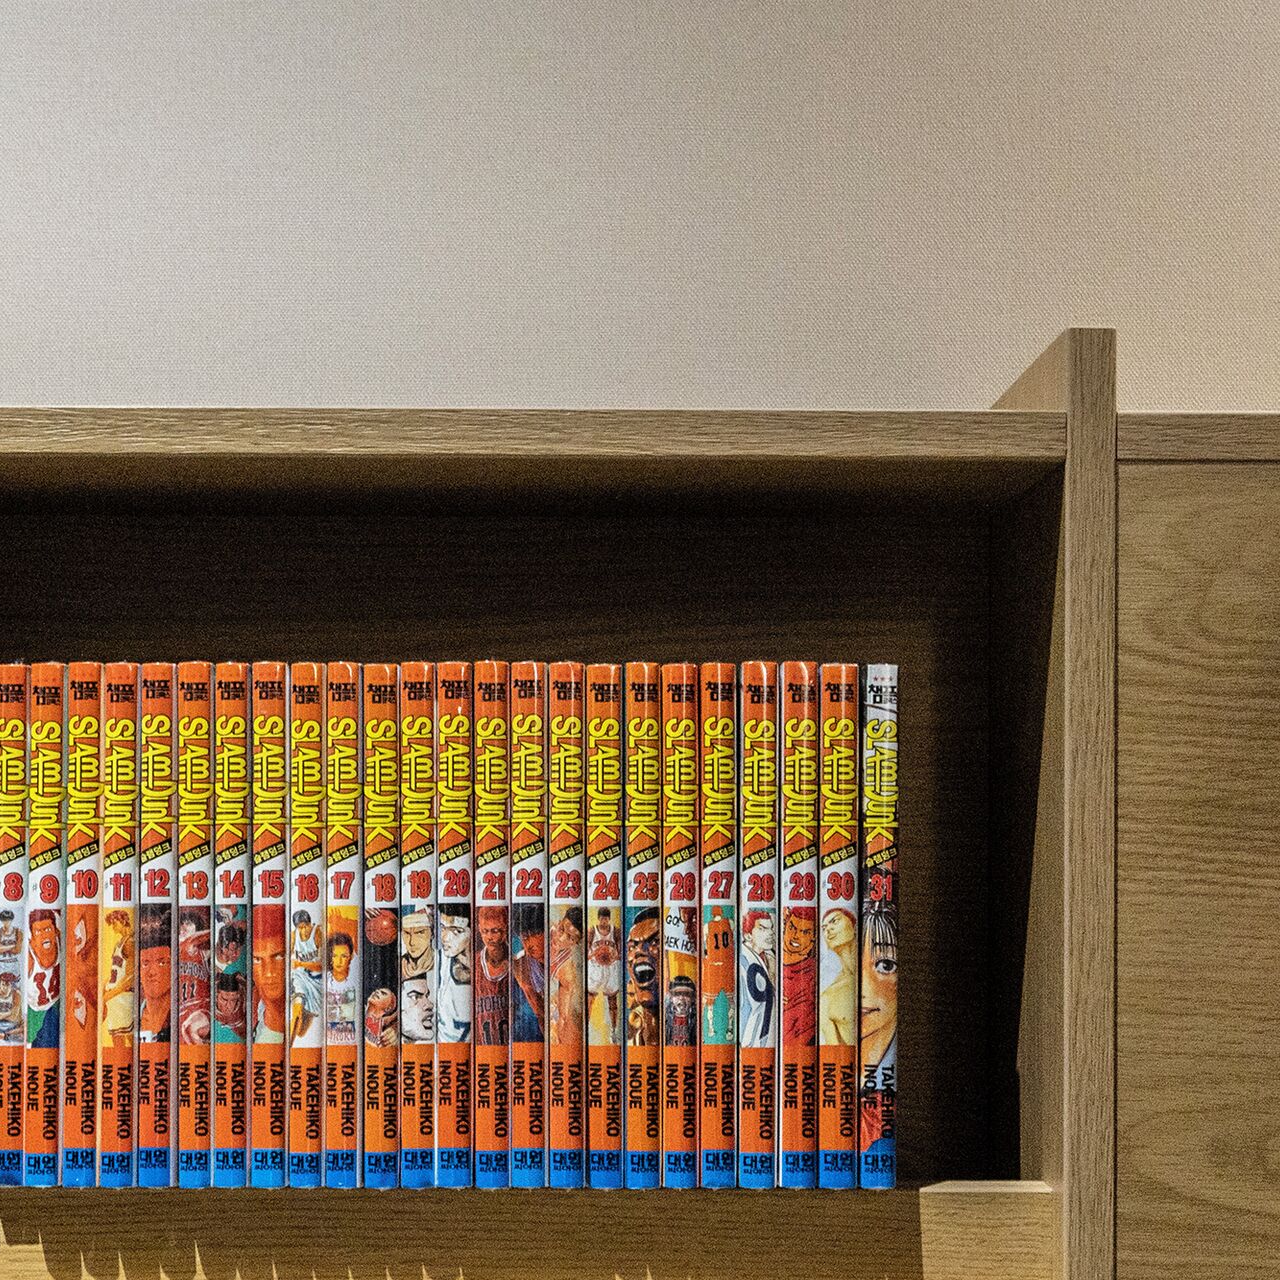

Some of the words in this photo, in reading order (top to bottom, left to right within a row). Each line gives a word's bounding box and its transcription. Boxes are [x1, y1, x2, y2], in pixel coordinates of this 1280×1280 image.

[3, 873, 23, 901] 8
[39, 875, 59, 903] 9
[72, 870, 99, 898] 10
[110, 873, 131, 901] 11
[144, 869, 169, 897] 12
[183, 871, 208, 899] 13
[219, 870, 244, 897] 14
[259, 870, 284, 897] 15
[295, 874, 319, 902] 16
[332, 871, 354, 899] 17
[372, 874, 395, 902] 18
[408, 871, 431, 899] 19
[444, 869, 470, 897] 20
[482, 871, 505, 900] 21
[516, 869, 542, 897] 22
[555, 870, 580, 898] 23
[593, 872, 619, 901] 24
[633, 873, 658, 900] 25
[671, 872, 695, 900] 26
[709, 870, 731, 899] 27
[748, 874, 774, 901] 28
[789, 872, 815, 901] 29
[827, 872, 854, 900] 30
[870, 873, 893, 901] 31
[7, 1063, 22, 1137] TAKEHIKO
[27, 1066, 38, 1111] INOUE
[43, 1066, 58, 1140] TAKEHIKO
[65, 1060, 76, 1105] INOUE
[81, 1060, 96, 1134] TAKEHIKO
[101, 1064, 112, 1109] INOUE
[117, 1064, 132, 1138] TAKEHIKO
[139, 1060, 150, 1105] INOUE
[154, 1060, 169, 1134] TAKEHIKO
[179, 1062, 190, 1107] INOUE
[194, 1062, 209, 1136] TAKEHIKO
[215, 1061, 226, 1106] INOUE
[231, 1061, 246, 1135] TAKEHIKO
[254, 1061, 265, 1106] INOUE
[270, 1061, 285, 1135] TAKEHIKO
[290, 1065, 301, 1110] INOUE
[305, 1065, 320, 1139] TAKEHIKO
[326, 1062, 337, 1107] INOUE
[341, 1062, 356, 1136] TAKEHIKO
[367, 1064, 378, 1109] INOUE
[383, 1064, 398, 1138] TAKEHIKO
[403, 1061, 414, 1106] INOUE
[419, 1061, 434, 1135] TAKEHIKO
[440, 1060, 451, 1105] INOUE
[455, 1060, 470, 1134] TAKEHIKO
[478, 1063, 489, 1108] INOUE
[494, 1063, 509, 1137] TAKEHIKO
[513, 1060, 524, 1105] INOUE
[529, 1060, 544, 1134] TAKEHIKO
[552, 1061, 563, 1106] INOUE
[568, 1062, 583, 1136] TAKEHIKO
[590, 1063, 601, 1108] INOUE
[606, 1063, 621, 1137] TAKEHIKO
[630, 1063, 641, 1108] INOUE
[645, 1064, 660, 1138] TAKEHIKO
[667, 1063, 678, 1108] INOUE
[682, 1064, 697, 1138] TAKEHIKO
[705, 1062, 716, 1107] INOUE
[720, 1062, 735, 1136] TAKEHIKO
[743, 1065, 754, 1110] INOUE
[759, 1065, 774, 1139] TAKEHIKO
[786, 1063, 797, 1108] INOUE
[801, 1064, 816, 1138] TAKEHIKO
[824, 1062, 835, 1107] INOUE
[840, 1063, 855, 1137] TAKEHIKO
[865, 1064, 876, 1109] INOUE
